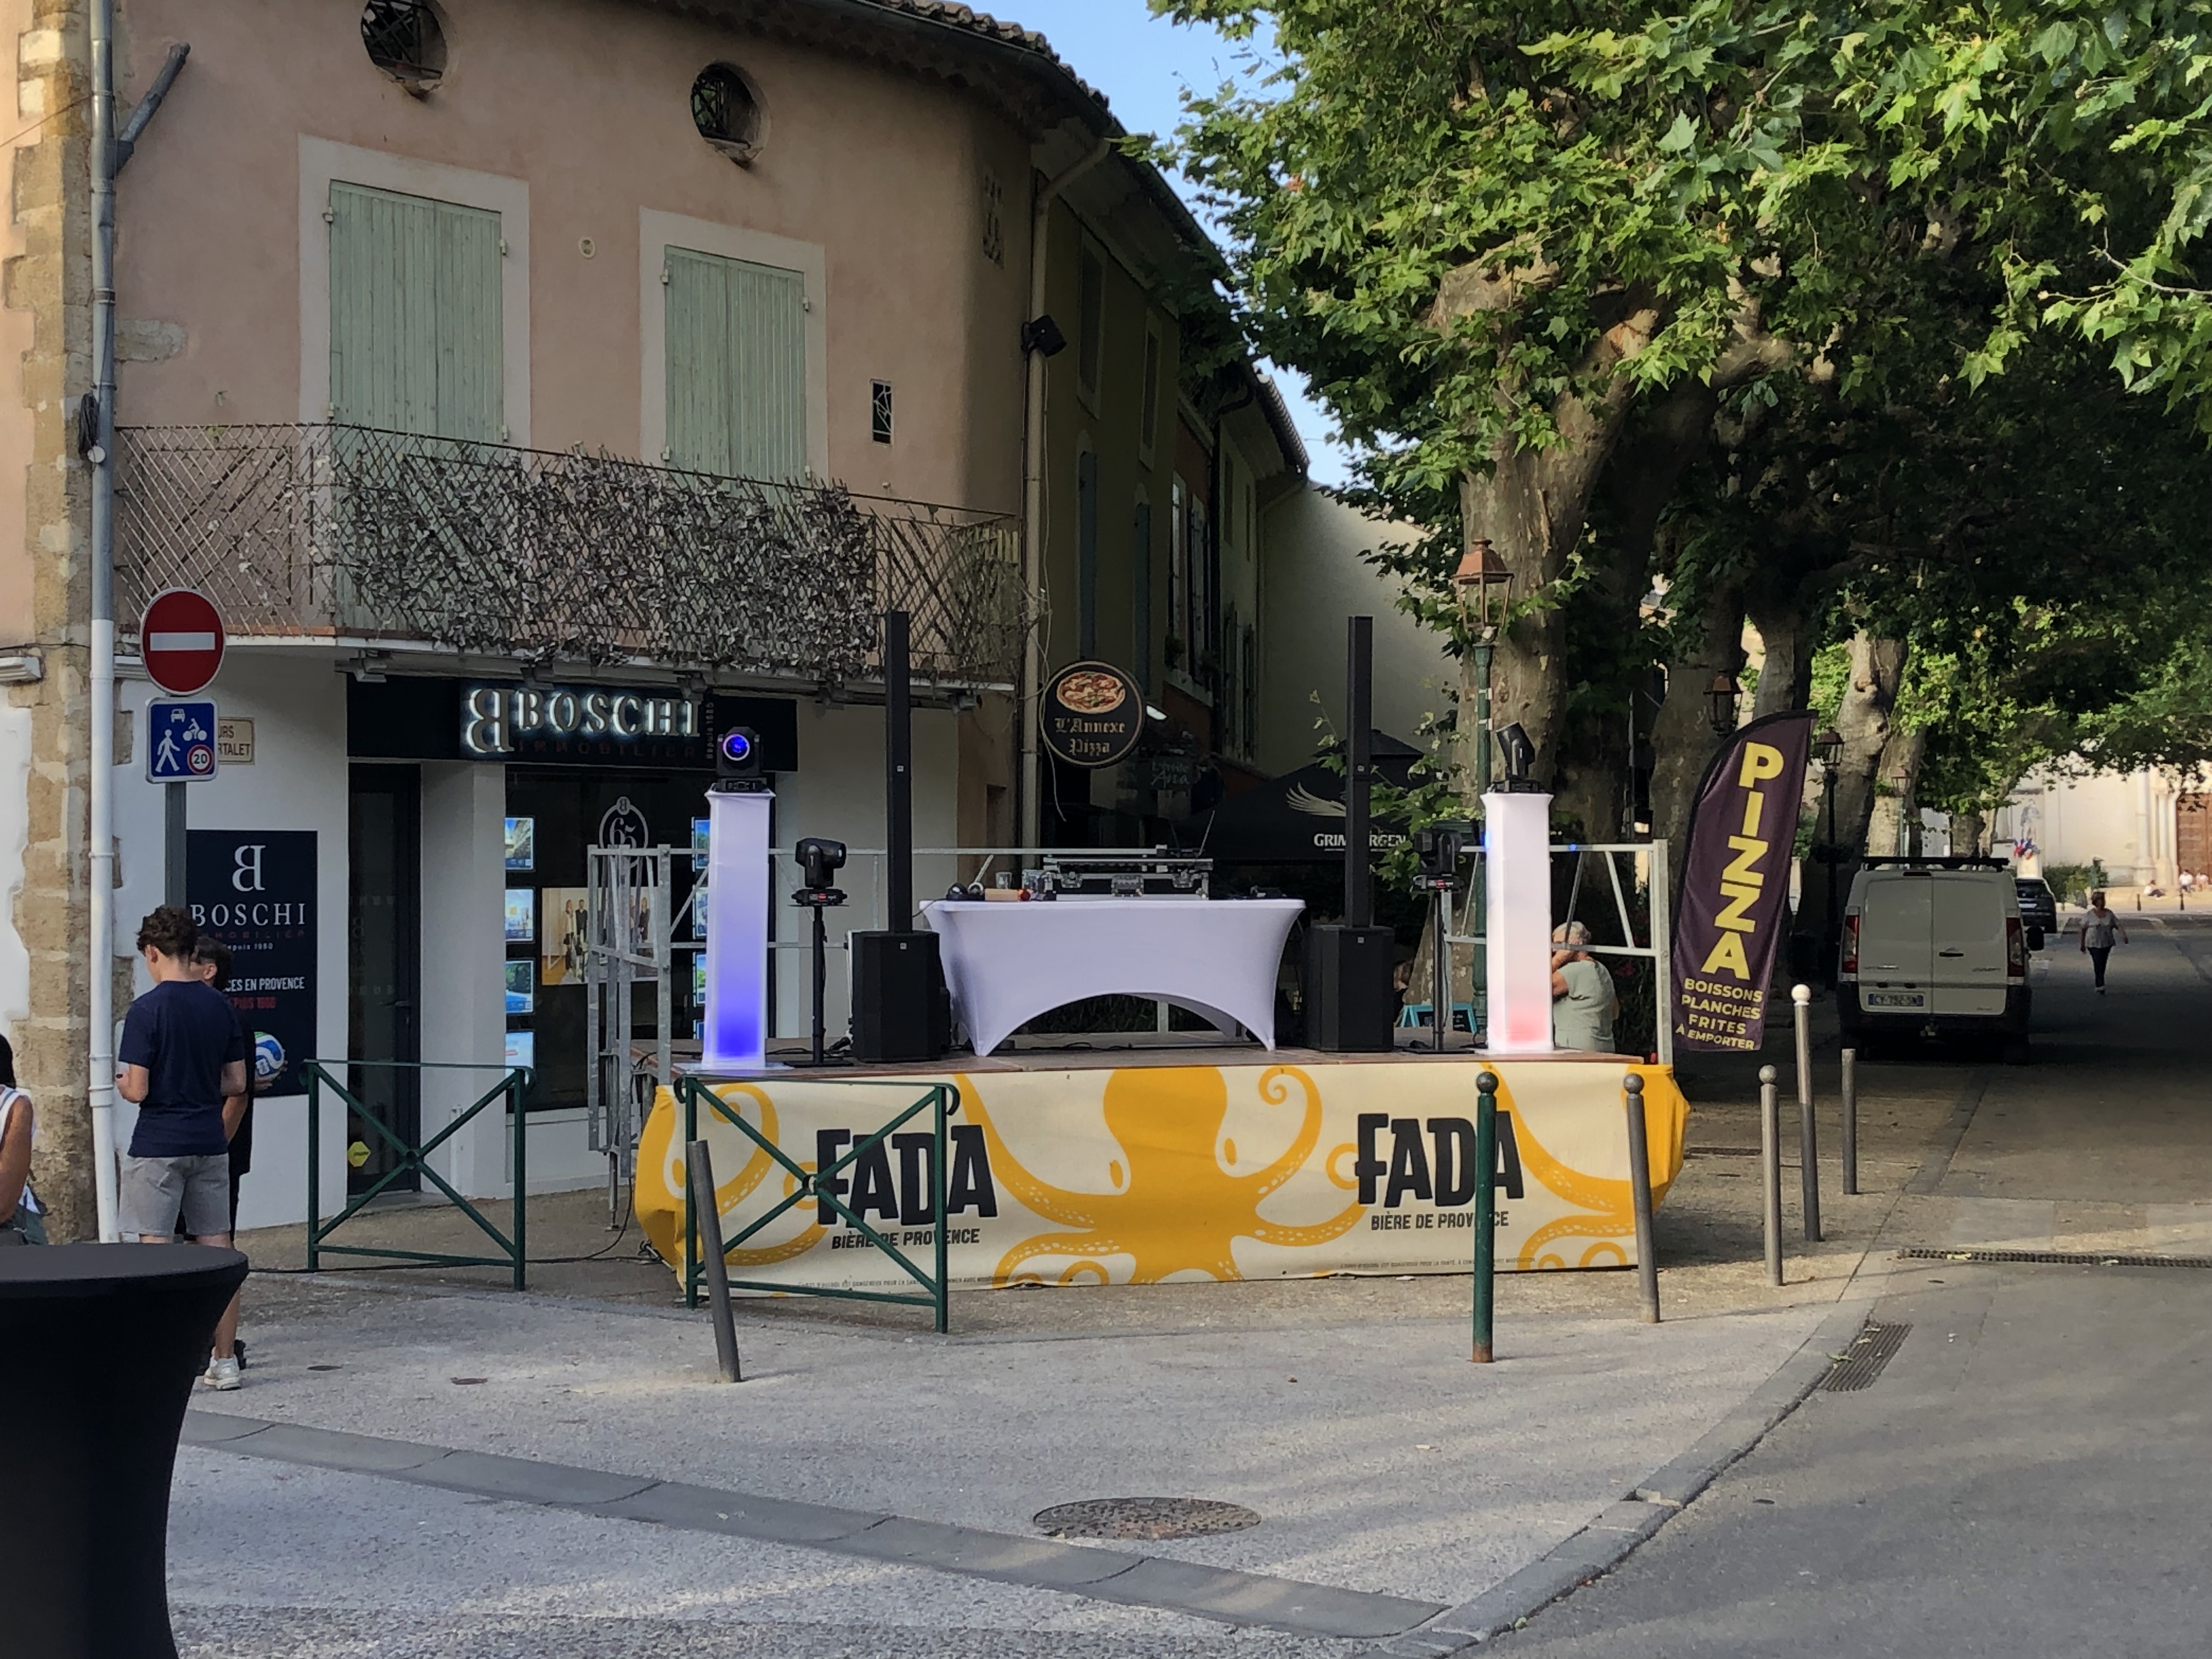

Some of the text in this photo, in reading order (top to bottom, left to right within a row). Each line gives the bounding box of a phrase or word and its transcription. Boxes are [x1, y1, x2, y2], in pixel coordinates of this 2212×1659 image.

[517, 688, 701, 737] BOSCHI
[218, 725, 234, 738] URS
[218, 743, 250, 755] RTALET
[1069, 738, 1110, 757] Pizza
[194, 754, 208, 764] 20
[1314, 833, 1406, 847] GRIMRGEN
[1701, 742, 1784, 980] PIZZA
[190, 903, 306, 927] BOSCHI
[245, 978, 257, 991] EN
[259, 977, 305, 990] PROVENCE
[1684, 978, 1763, 1002] BOISSONS
[1681, 994, 1761, 1020] PLANCHES
[1688, 1013, 1747, 1035] FRITES
[1687, 1029, 1756, 1050] EMPORTER
[1355, 1110, 1525, 1207] FADA
[817, 1125, 998, 1228] FADA
[1371, 1210, 1509, 1231] BIÈRE DE PROVCE
[903, 1228, 980, 1245] PROENCE
